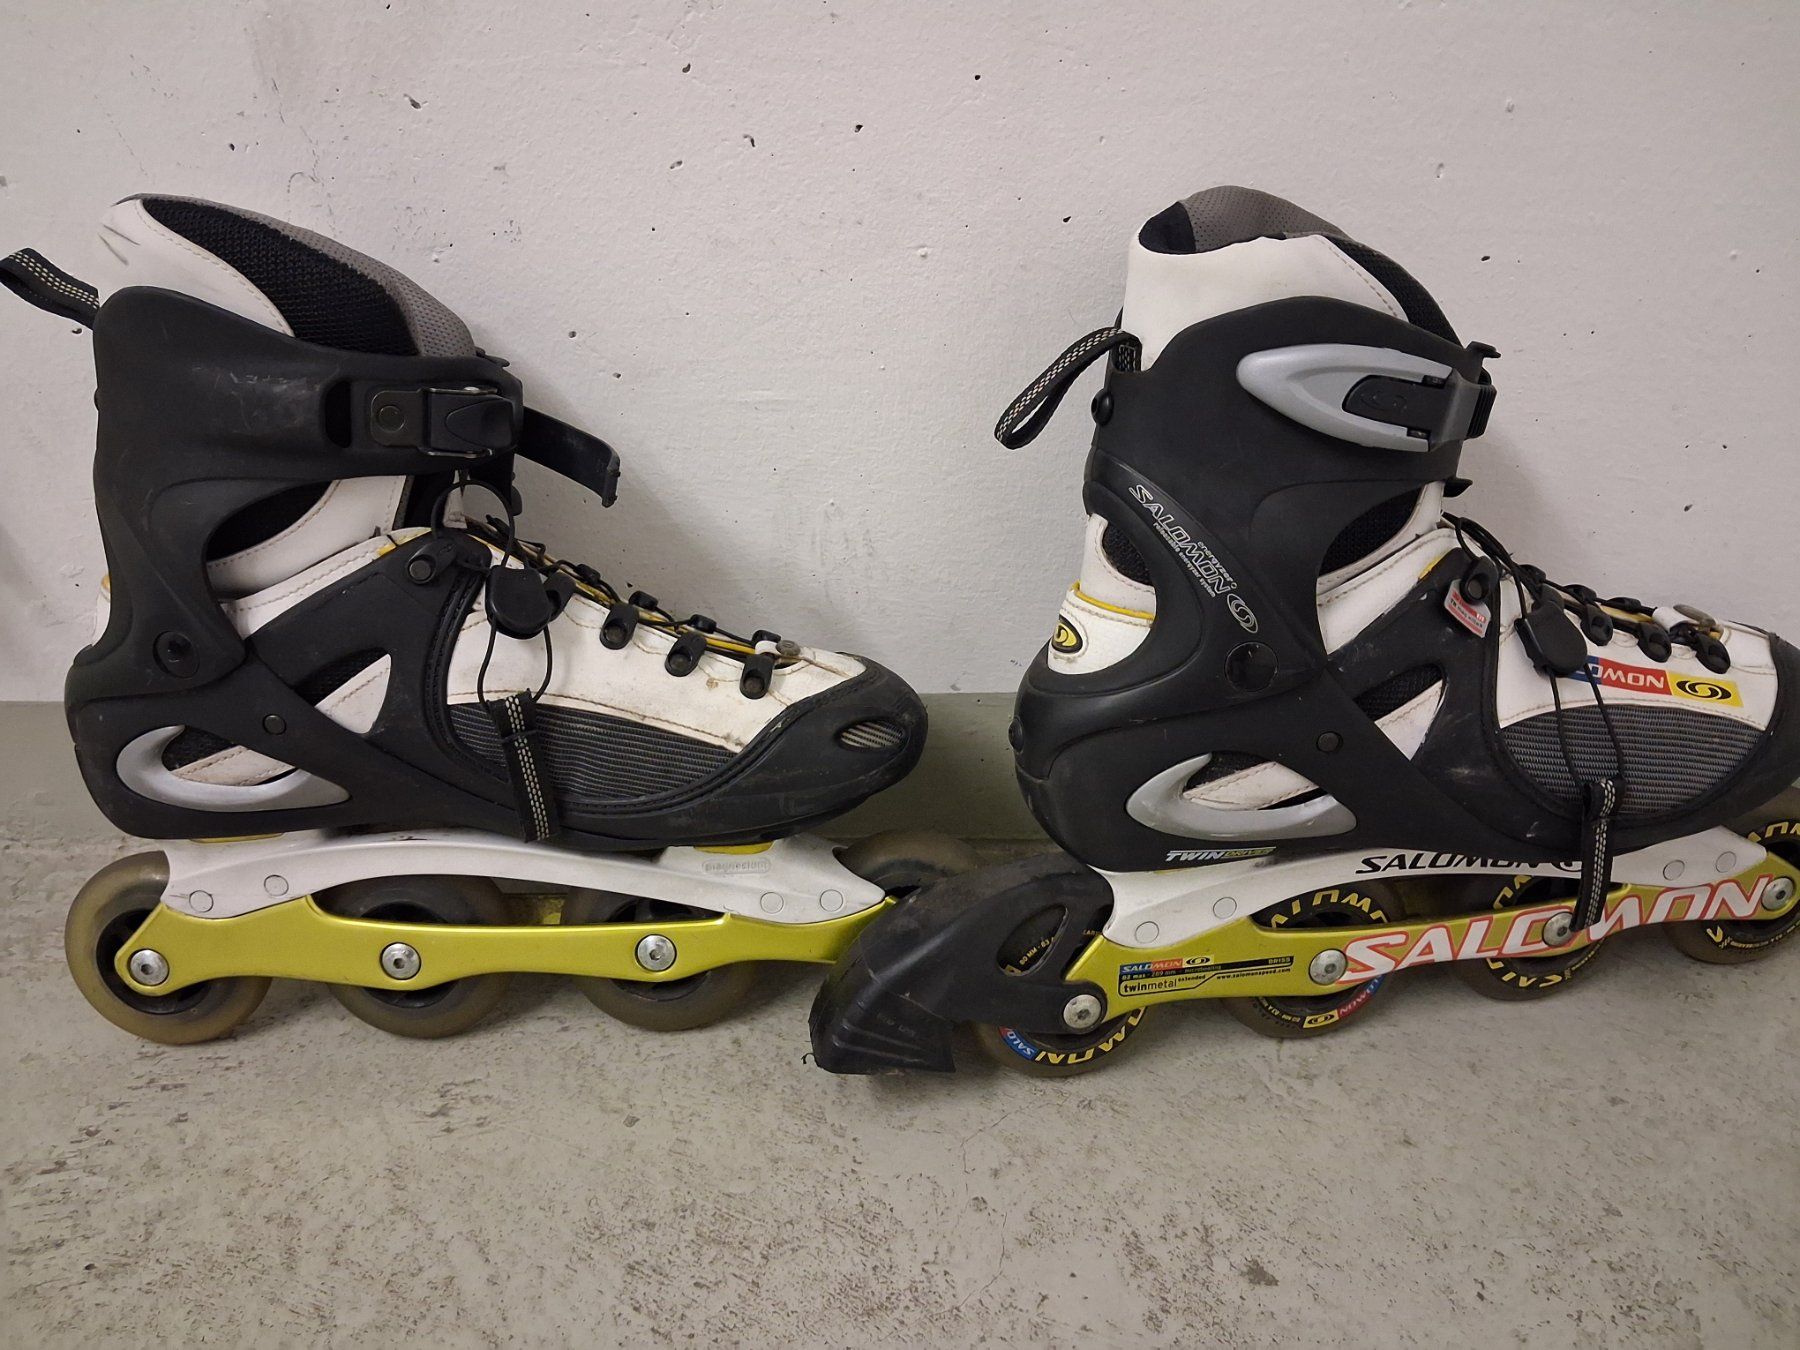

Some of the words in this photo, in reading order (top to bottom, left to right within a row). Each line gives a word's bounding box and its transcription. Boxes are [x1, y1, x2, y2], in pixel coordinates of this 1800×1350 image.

[1129, 484, 1232, 594] SALOMON
[1576, 662, 1665, 689] OMON
[1122, 960, 1182, 973] SALOMON
[1123, 979, 1177, 994] twinmetal
